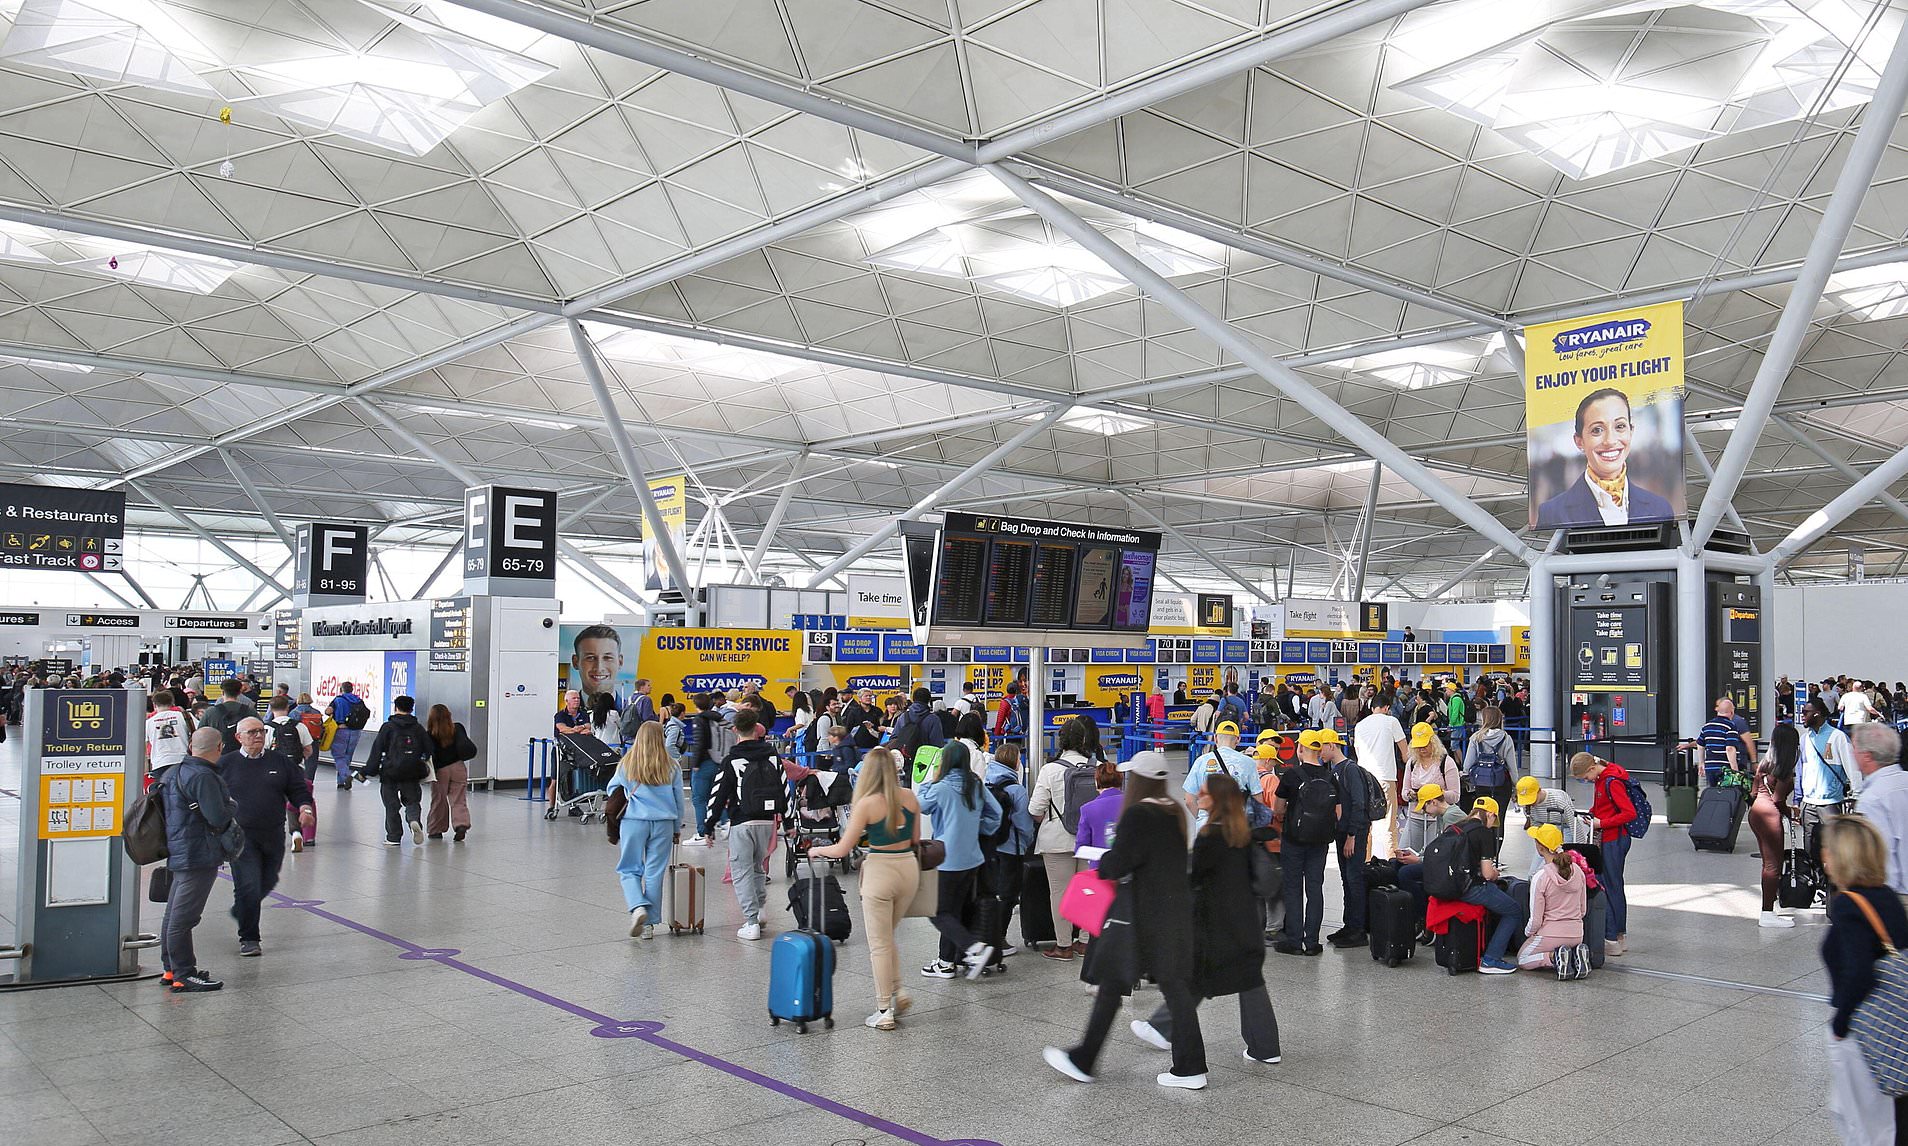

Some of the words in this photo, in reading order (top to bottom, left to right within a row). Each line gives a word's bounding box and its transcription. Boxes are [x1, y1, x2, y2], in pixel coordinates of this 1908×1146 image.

[1569, 323, 1645, 345] RYANAIR
[1559, 350, 1574, 361] Low
[1599, 343, 1624, 358] great
[1625, 342, 1644, 350] care
[1535, 370, 1578, 390] ENJOY
[1581, 365, 1617, 384] YOUR
[1621, 357, 1671, 378] FLIGHT
[653, 488, 675, 497] RYANAIR
[6, 505, 18, 518] &
[22, 506, 119, 524] Restaurants
[469, 494, 486, 548] E
[504, 495, 544, 549] E
[1001, 521, 1018, 533] Bag
[1021, 523, 1041, 536] Drop
[1043, 526, 1059, 535] and
[1060, 527, 1086, 539] Check
[1088, 529, 1095, 538] In
[1097, 531, 1140, 544] Information
[297, 529, 308, 572] F
[323, 529, 356, 571] F
[33, 553, 76, 567] Track
[467, 557, 484, 572] 65-79
[503, 558, 544, 572] 65-79
[320, 579, 356, 590] 81-95
[858, 591, 880, 603] Take
[882, 592, 902, 604] time
[97, 617, 134, 625] Access
[1289, 610, 1302, 619] Take
[1303, 611, 1317, 621] flight
[1734, 611, 1756, 620] Departures
[179, 618, 235, 629] Departures
[312, 620, 342, 636] Welcome
[382, 617, 412, 638] Airport
[657, 635, 732, 651] CUSTOMER
[735, 637, 790, 651] SERVICE
[814, 632, 828, 644] 65
[1161, 639, 1171, 648] 70
[1179, 639, 1188, 648] 71
[1253, 641, 1262, 649] 72
[1269, 641, 1278, 649] 73
[1334, 642, 1342, 650] 74
[1348, 642, 1356, 650] 75
[1418, 643, 1425, 651] 77
[699, 653, 714, 662] CAN
[715, 653, 727, 662] WE
[728, 653, 750, 663] HELP?
[391, 661, 408, 685] 22KG
[974, 668, 991, 678] CAN
[992, 668, 1004, 678] WE
[1192, 668, 1203, 676] CAN
[1204, 668, 1214, 676] WE
[973, 678, 1003, 689] HELP?
[1193, 677, 1214, 686] HELP?
[45, 743, 82, 753] Trolley
[87, 743, 123, 752] Return
[46, 760, 82, 771] Trolley
[87, 760, 122, 768] return
